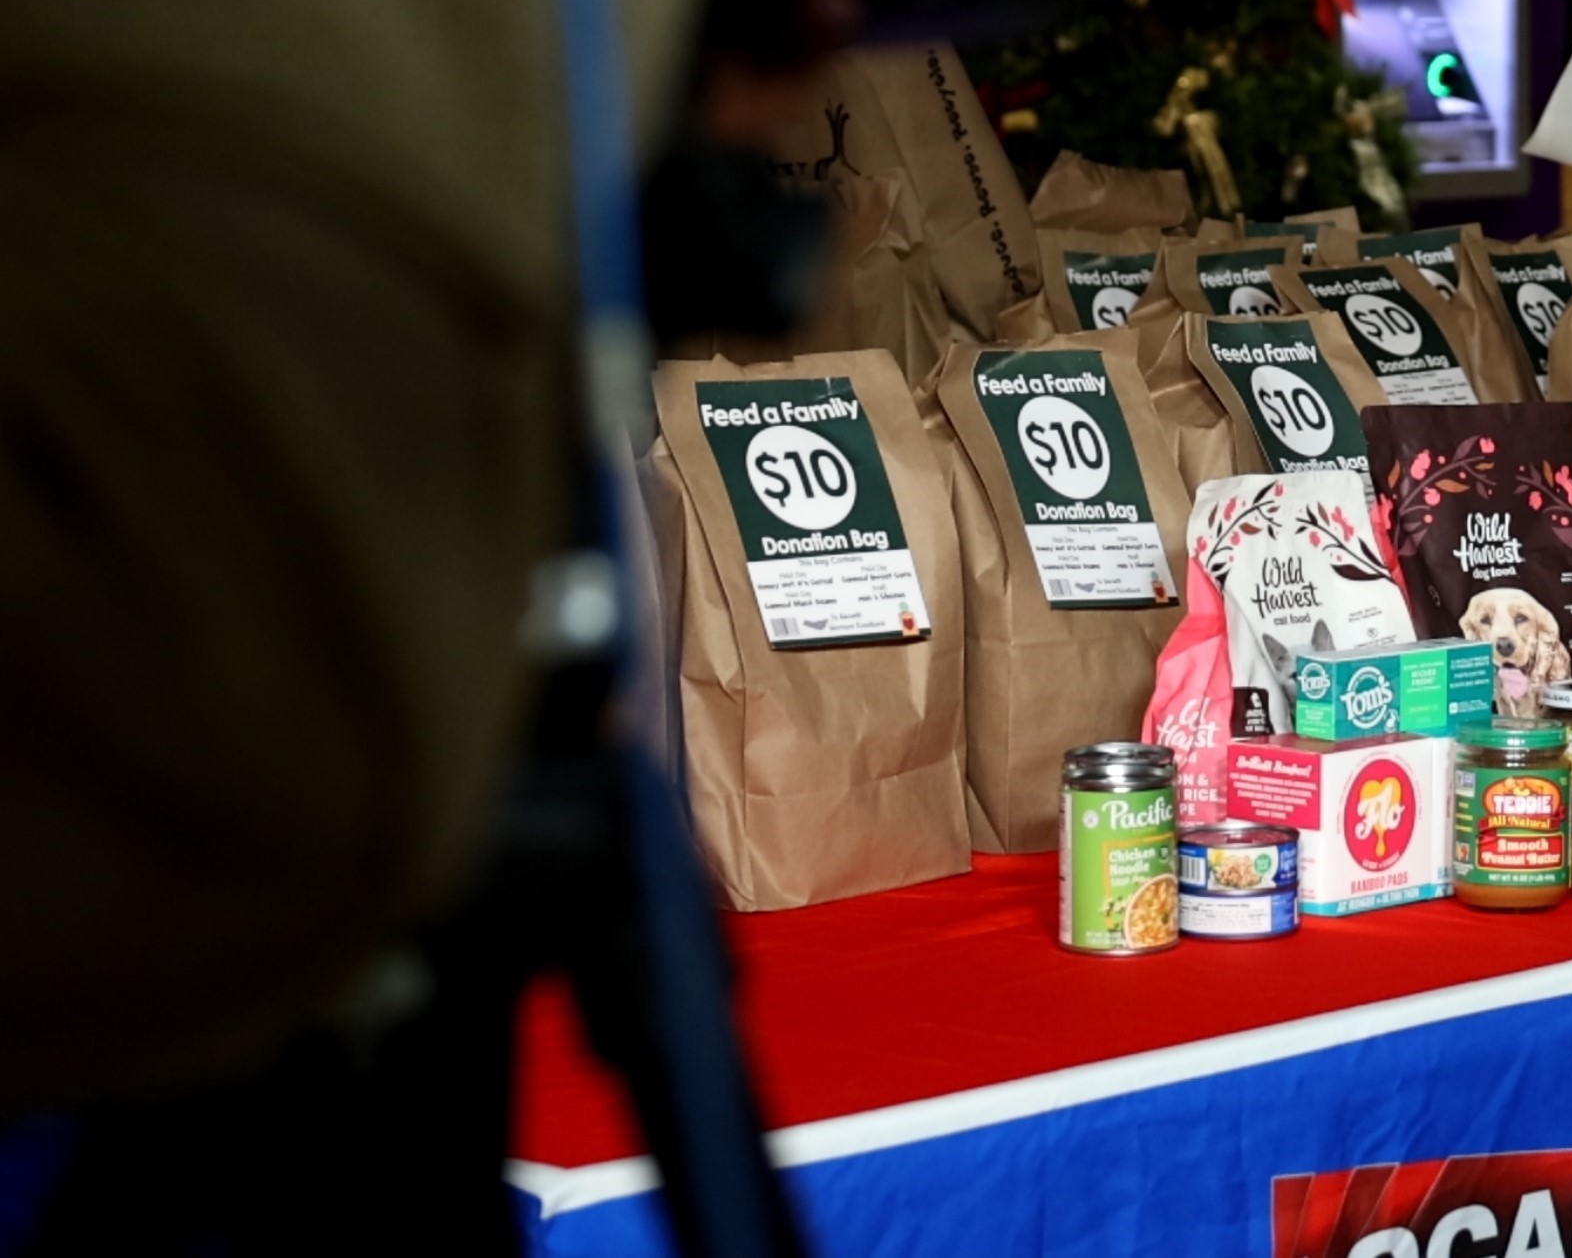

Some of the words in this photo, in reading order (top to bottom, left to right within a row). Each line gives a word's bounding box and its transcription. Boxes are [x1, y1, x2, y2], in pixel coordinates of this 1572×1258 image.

[989, 220, 1027, 297] educe.
[1200, 269, 1232, 288] Feed
[1528, 264, 1566, 282] Family
[1308, 281, 1346, 298] Feed
[1354, 277, 1401, 293] Family
[1353, 305, 1416, 342] $10
[1212, 343, 1252, 362] Feed
[1252, 347, 1265, 363] a
[1264, 342, 1317, 364] Family
[1376, 356, 1427, 373] Donation
[1425, 354, 1449, 369] Bag
[978, 374, 1029, 396] Feed
[1029, 377, 1045, 393] a
[1043, 372, 1106, 397] Family
[700, 401, 761, 428] Feed
[762, 406, 781, 425] a
[780, 397, 860, 424] Family
[1259, 386, 1326, 436] $10
[1025, 421, 1104, 476] $10
[754, 448, 848, 508] $10
[1035, 501, 1105, 521] Donation
[1105, 500, 1138, 522] Bag
[1466, 512, 1511, 543] Wild
[761, 530, 849, 556] Donation
[849, 528, 889, 551] Bag
[1452, 536, 1526, 573] Harvest
[1262, 556, 1304, 589] Wild
[1473, 568, 1490, 581] dog
[1490, 565, 1517, 578] food
[1251, 581, 1323, 619] Harvest
[1273, 615, 1289, 626] cat
[1289, 613, 1312, 626] food
[1297, 672, 1332, 692] Tom's
[1340, 675, 1394, 721] Tom's
[1183, 788, 1218, 802] RICE
[1492, 795, 1553, 816] TEDDIE
[1101, 796, 1174, 830] Pacific
[1487, 815, 1507, 829] All
[1508, 815, 1551, 830] Natural
[1109, 847, 1156, 863] Chicken
[1497, 838, 1550, 853] Smooth
[1110, 861, 1150, 877] Noodle
[1481, 851, 1525, 866] Peanut
[1525, 852, 1561, 866] Butter
